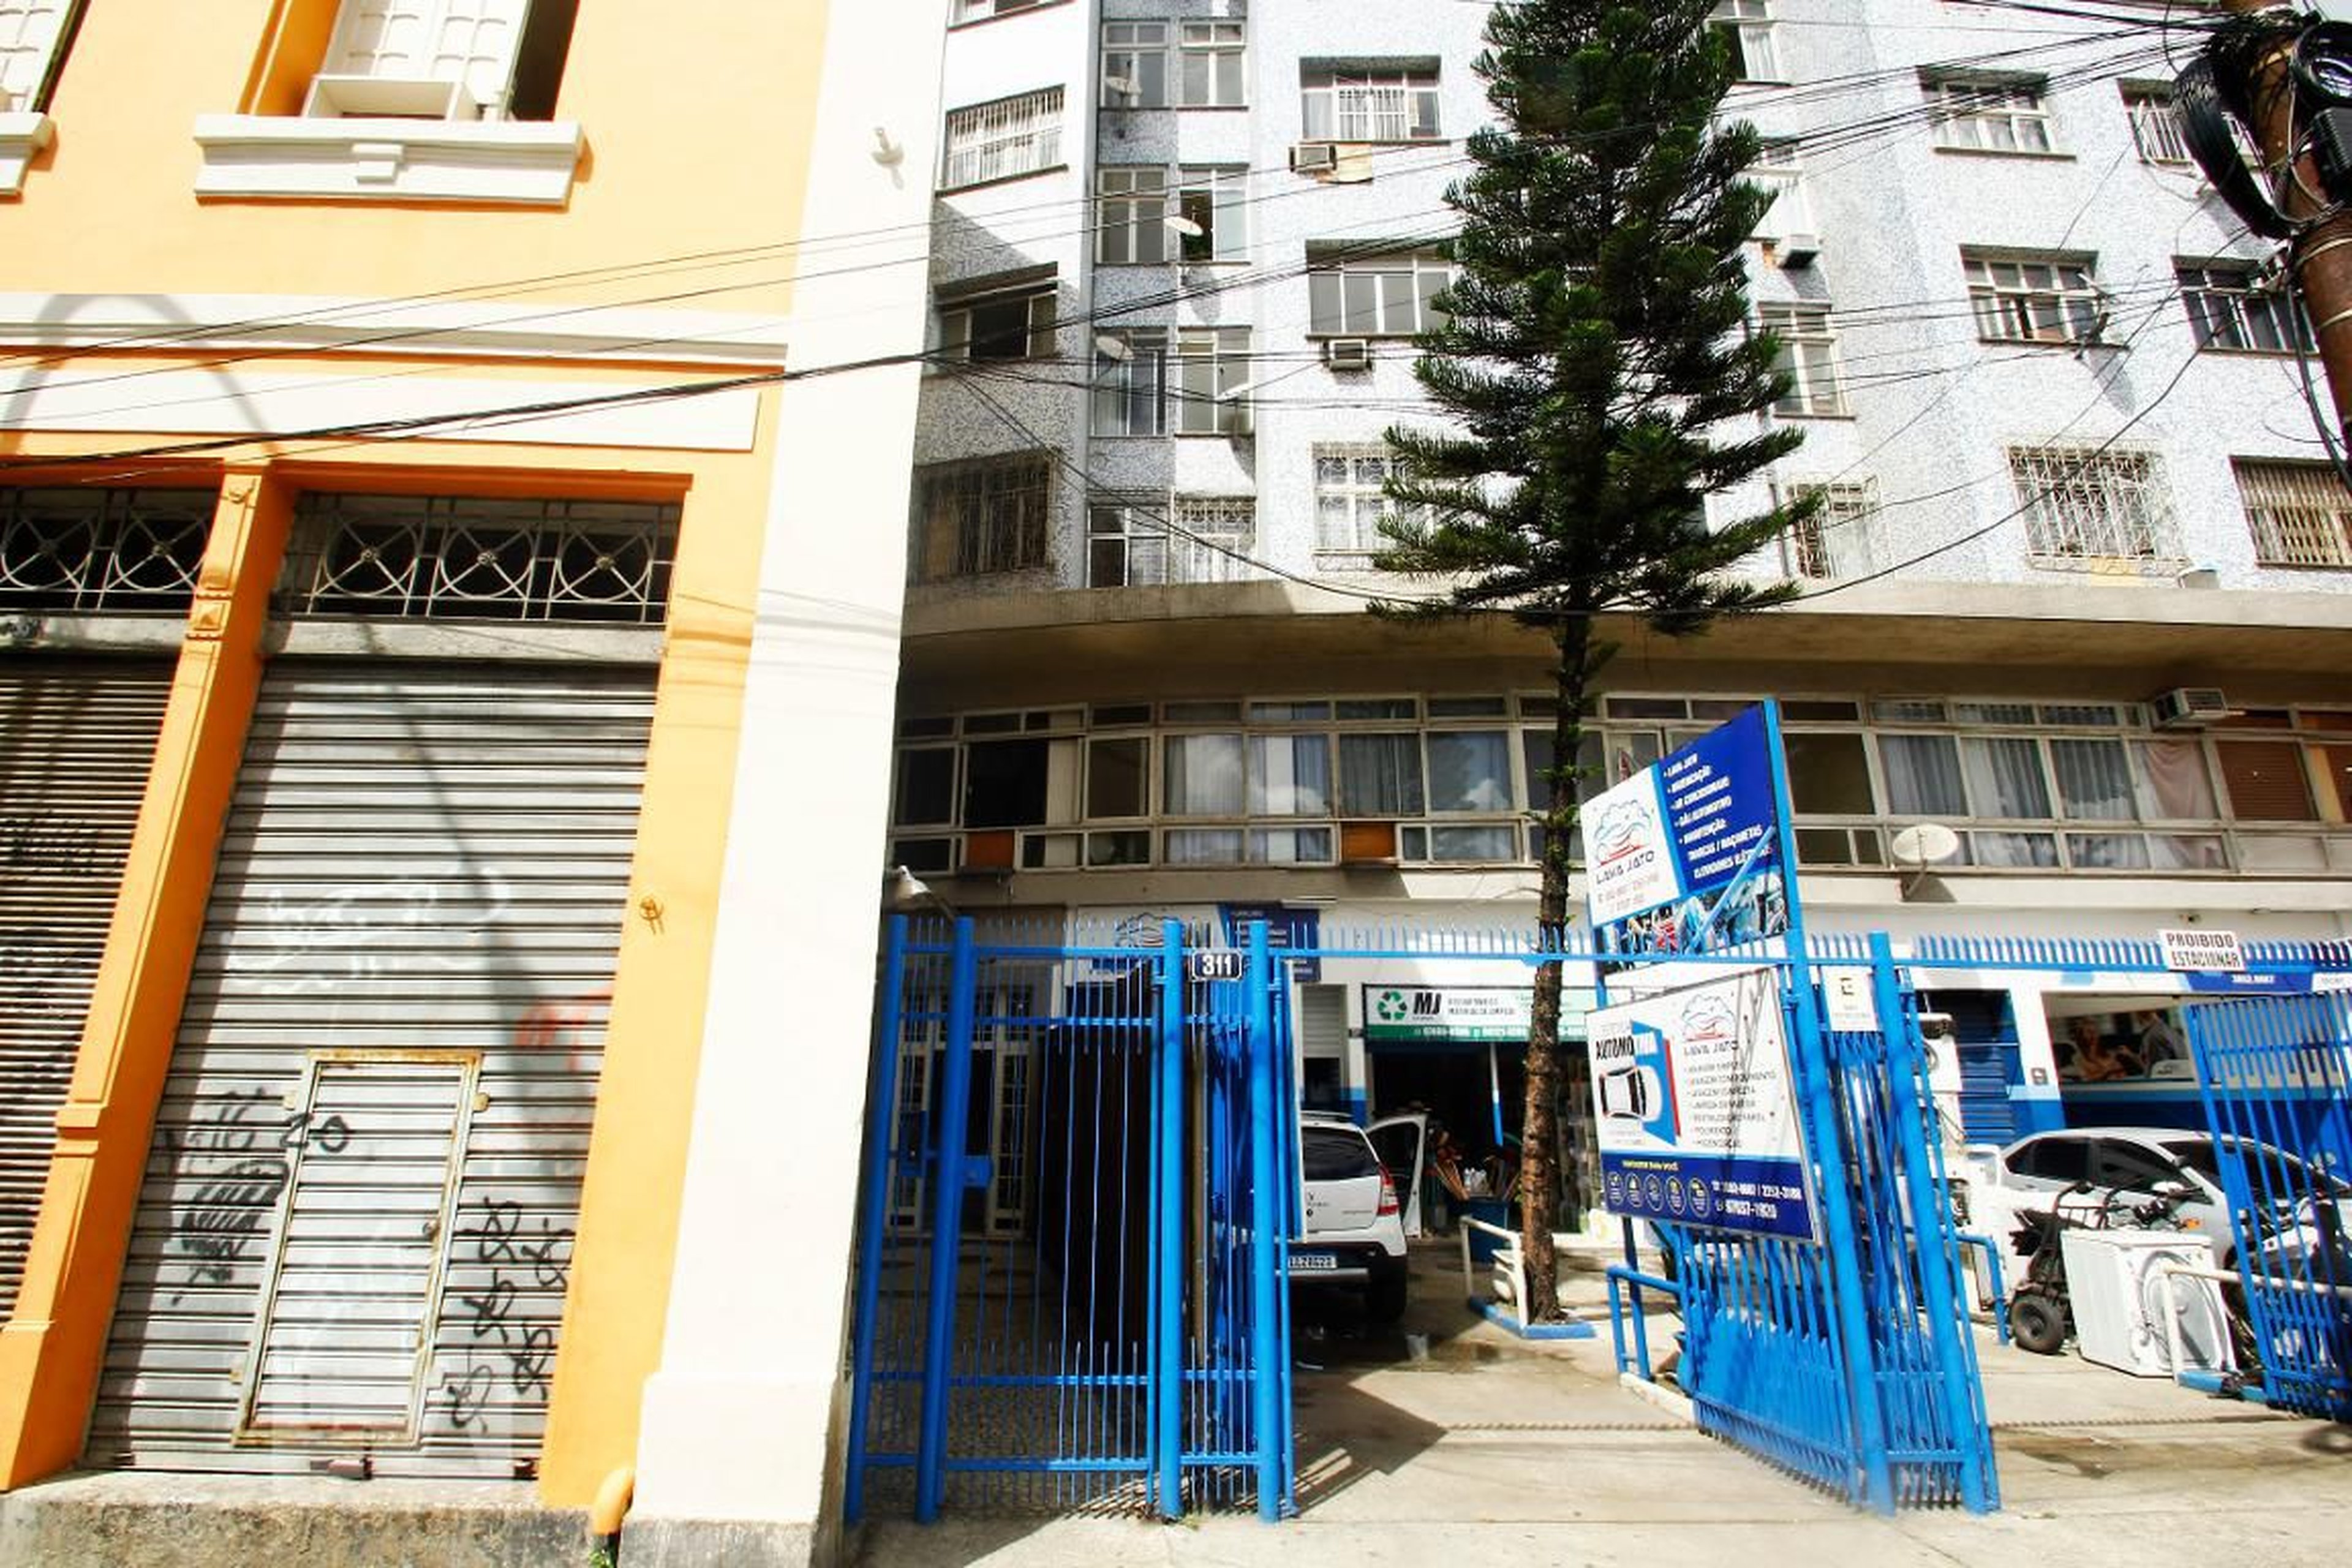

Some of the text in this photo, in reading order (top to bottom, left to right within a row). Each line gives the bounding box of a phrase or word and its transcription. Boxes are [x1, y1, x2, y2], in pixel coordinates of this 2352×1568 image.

[2166, 932, 2234, 948] PROIBIDO
[1201, 954, 1233, 976] 311
[2171, 951, 2241, 968] ESTACIONAR
[1413, 992, 1442, 1015] MJ
